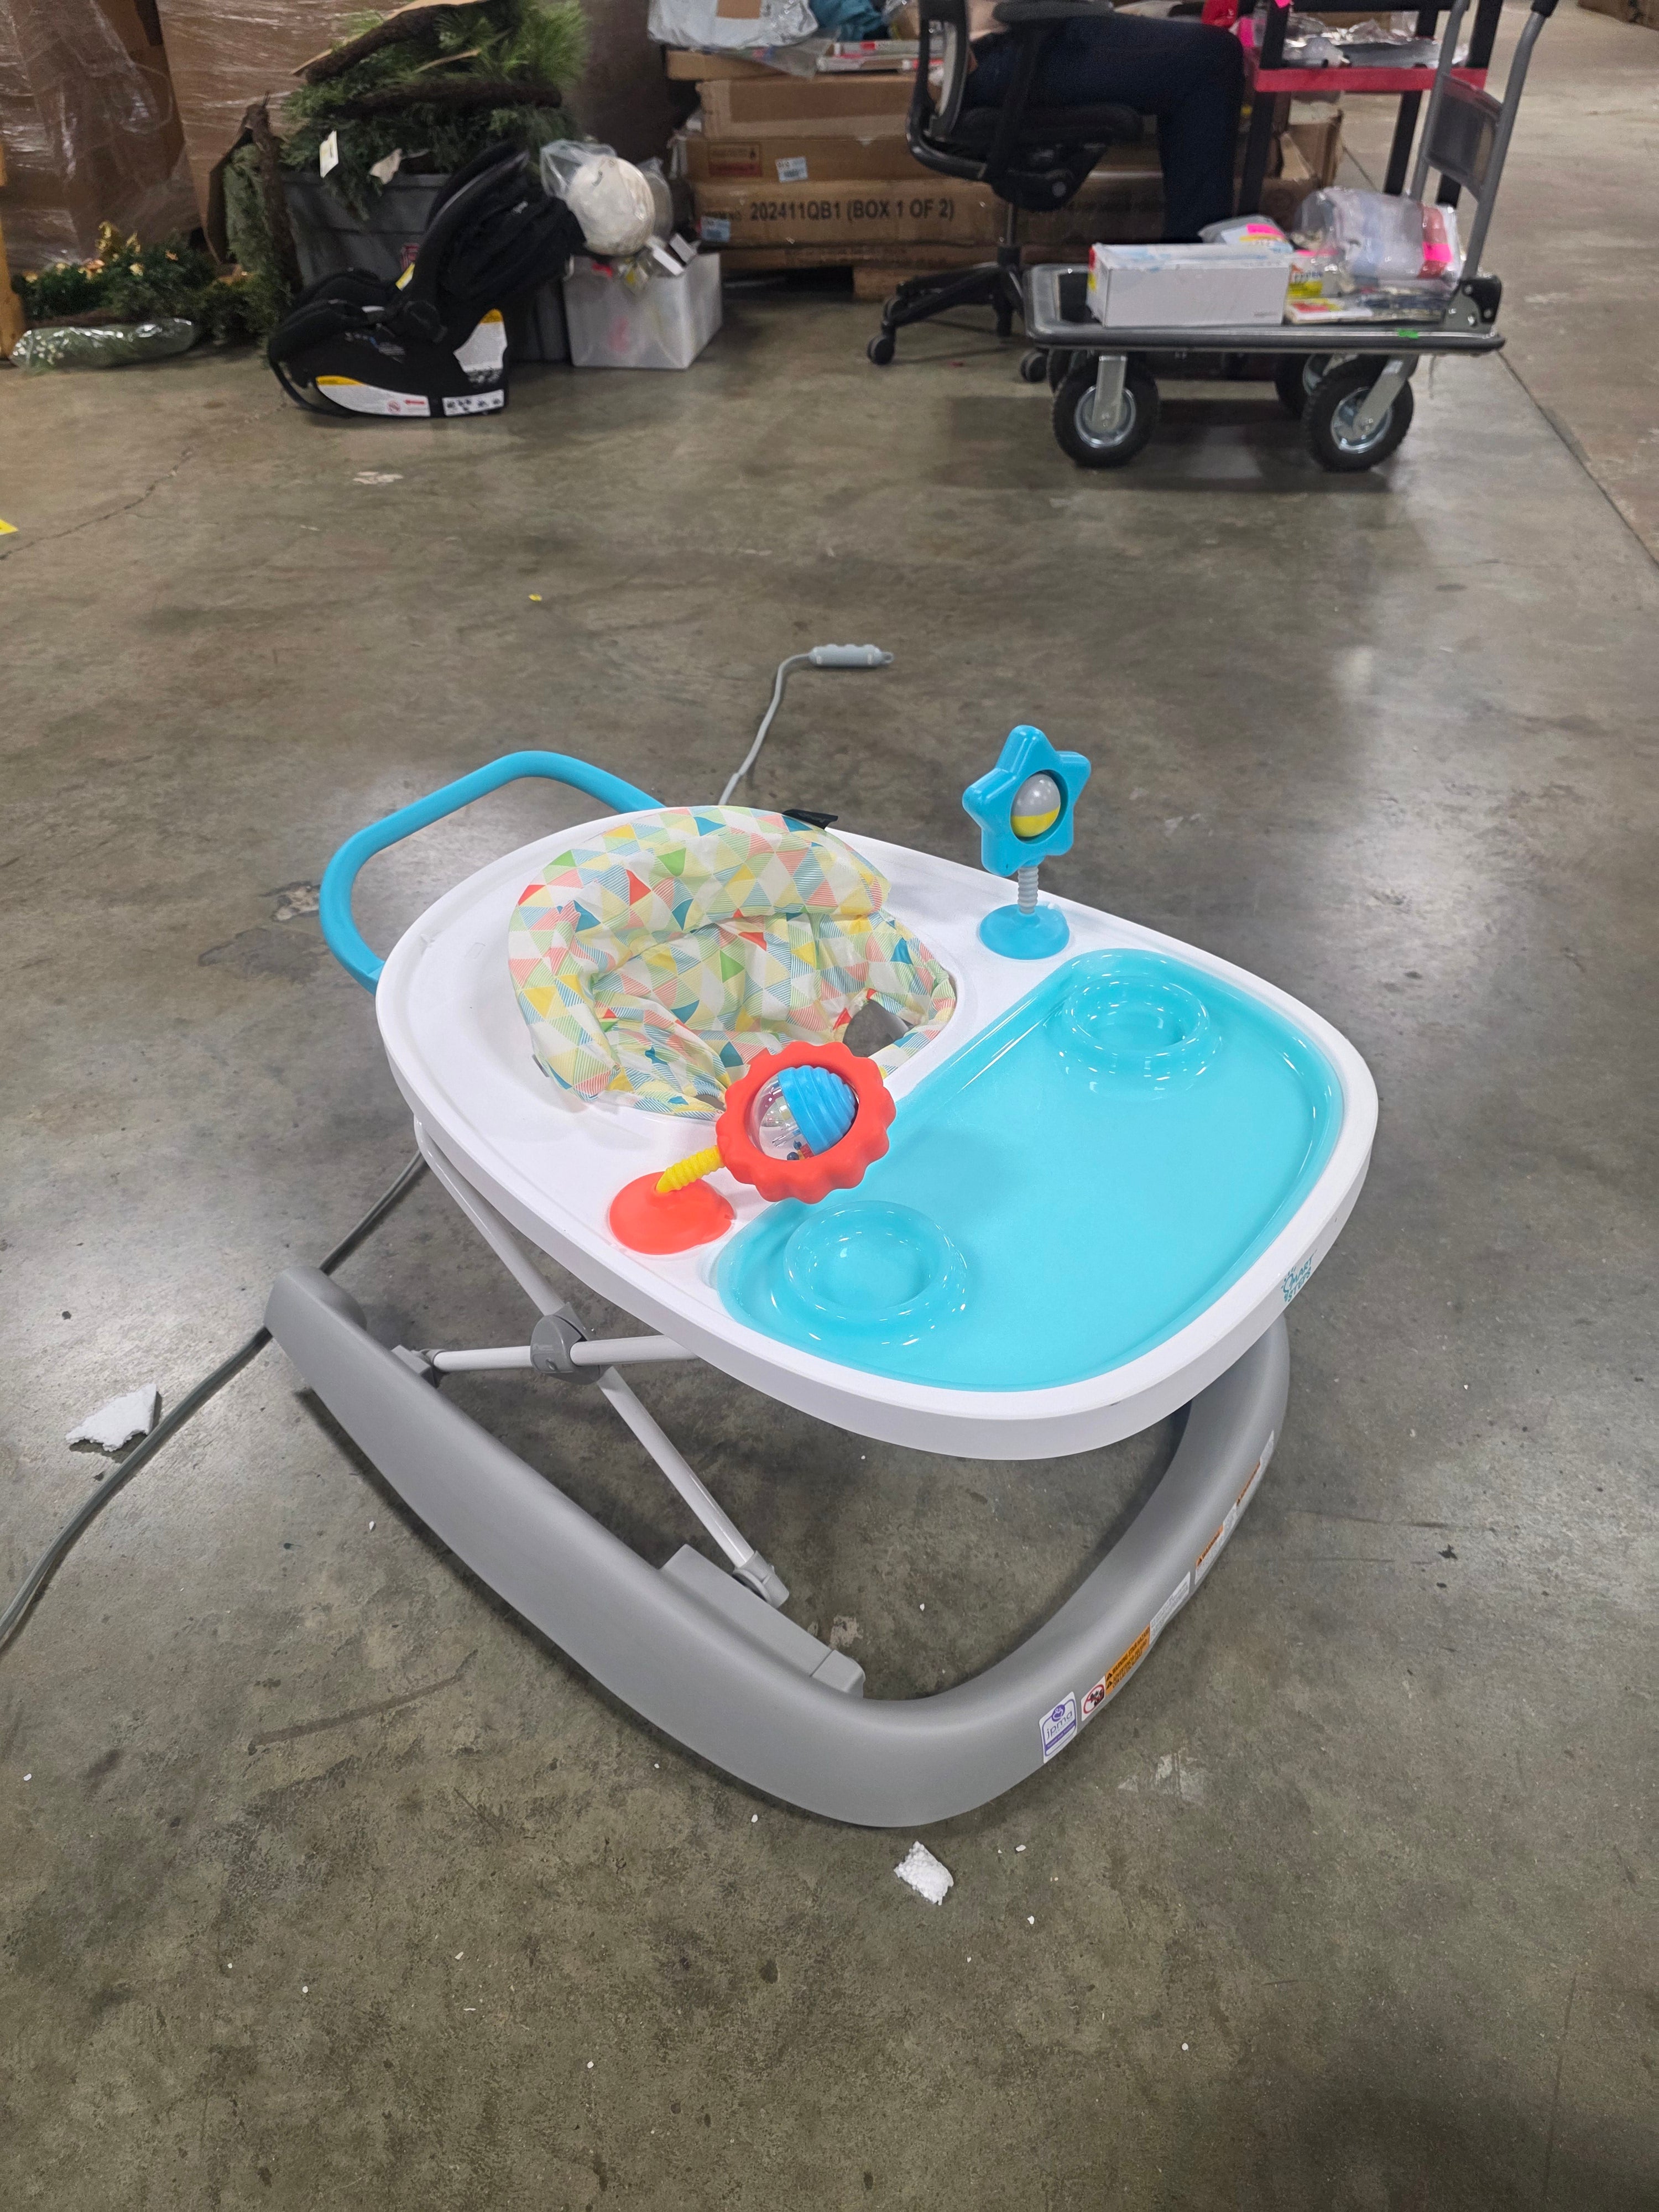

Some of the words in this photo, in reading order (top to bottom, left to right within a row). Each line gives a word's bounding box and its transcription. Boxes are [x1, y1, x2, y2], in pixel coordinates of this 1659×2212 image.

[750, 201, 841, 221] 202411QB1
[847, 200, 889, 219] (BOX
[897, 200, 903, 217] 1
[910, 199, 933, 217] OF
[938, 198, 955, 218] 2)
[1047, 1710, 1072, 1741] jpma
